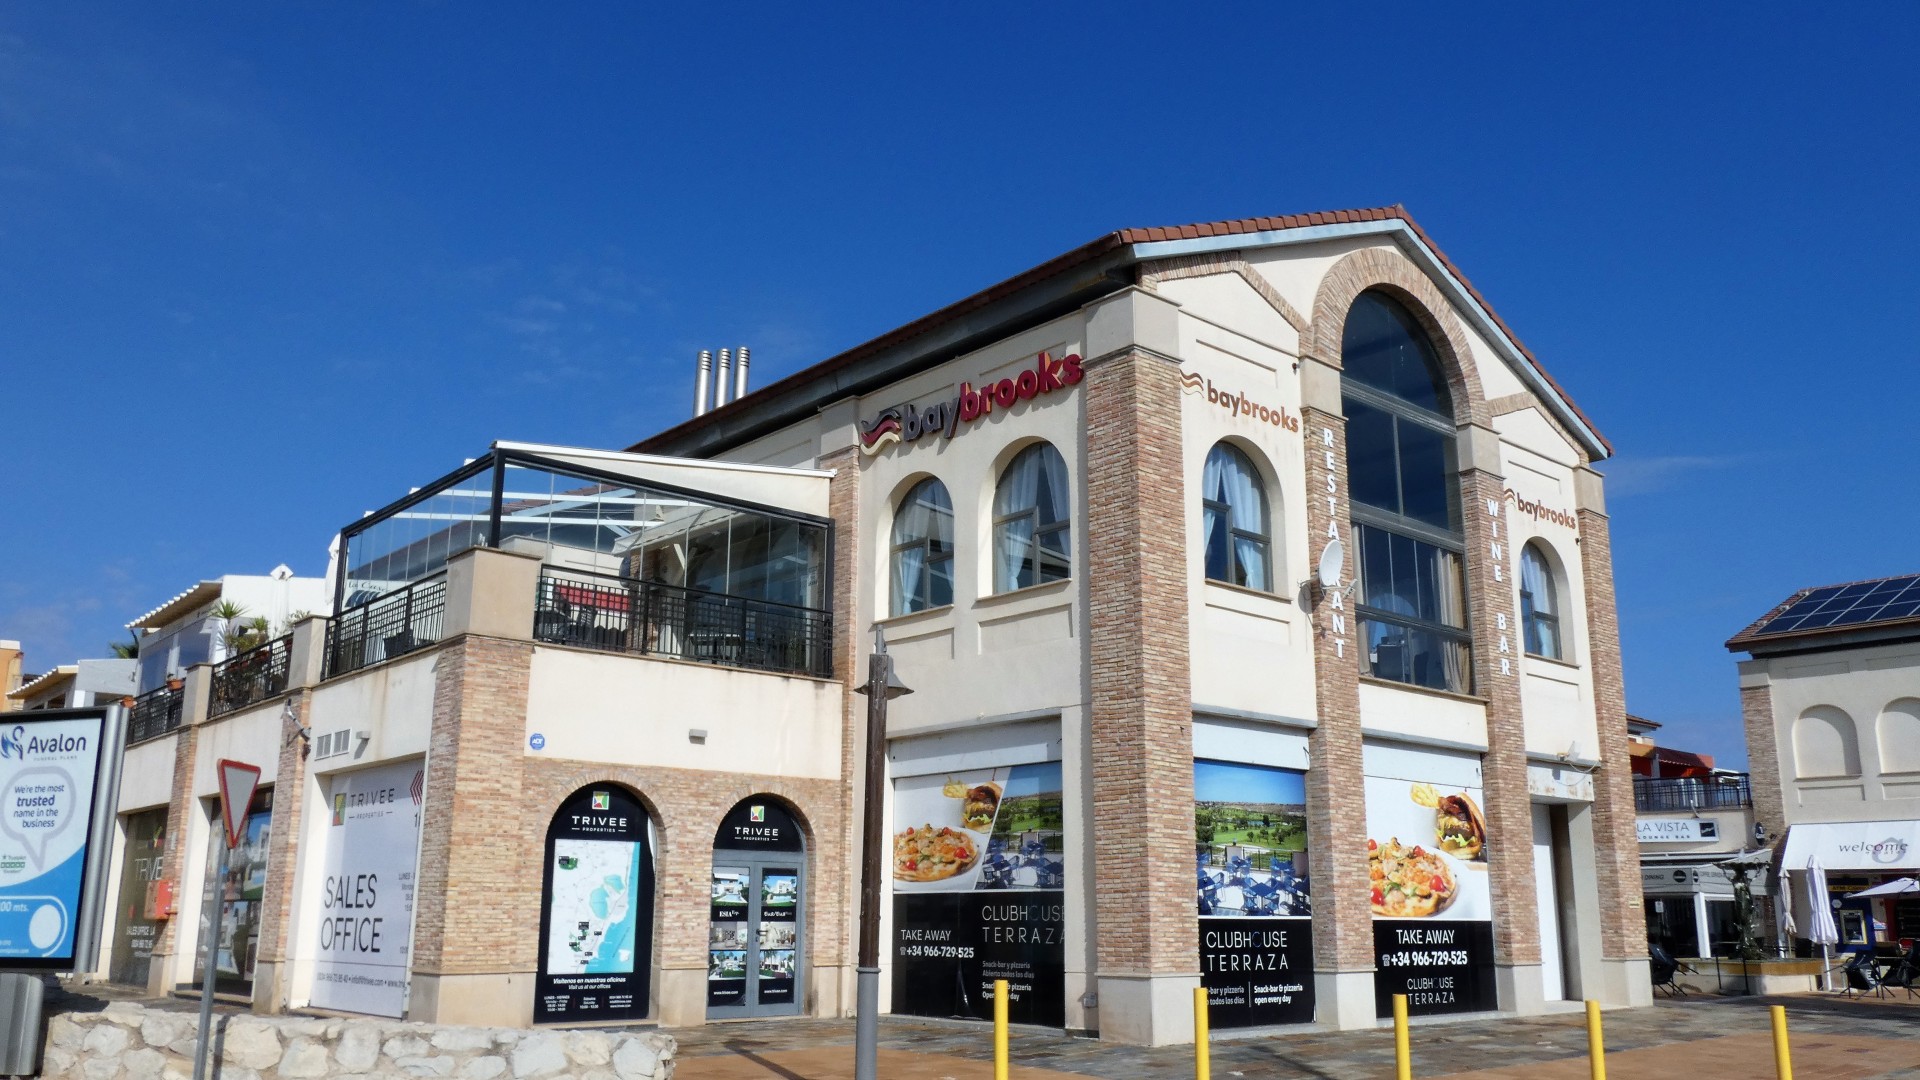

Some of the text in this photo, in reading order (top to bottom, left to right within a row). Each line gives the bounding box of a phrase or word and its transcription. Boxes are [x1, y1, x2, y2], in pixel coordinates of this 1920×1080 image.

[903, 351, 1084, 442] baybrooks
[1207, 379, 1299, 433] baybrooks
[1516, 492, 1576, 530] baybrooks
[1323, 428, 1345, 659] RESTAANT
[1487, 499, 1510, 676] WINE BAR
[27, 734, 87, 754] Avalon
[15, 784, 64, 793] We're the most
[17, 795, 55, 807] trusted
[350, 788, 395, 807] TRIVEE
[14, 808, 58, 818] name in the
[22, 819, 55, 828] business
[571, 815, 627, 827] TRIVEE
[1654, 822, 1690, 832] VISTA
[735, 826, 779, 836] TRIVEE
[1839, 842, 1908, 852] welcome
[324, 874, 377, 909] SALES
[321, 917, 383, 953] OFFICE
[901, 930, 951, 941] TAKE AWAY
[1396, 929, 1455, 944] TAKE AWAY
[907, 946, 974, 958] +34 966-729-525
[1207, 954, 1289, 971] TERRAZA
[1391, 951, 1468, 966] +34 966-729-525
[1254, 985, 1278, 993] Snack-bar
[1283, 983, 1303, 993] pizzeria
[1010, 992, 1020, 1002] day
[1254, 995, 1291, 1005] open every day
[1407, 992, 1455, 1004] TERRAZA
